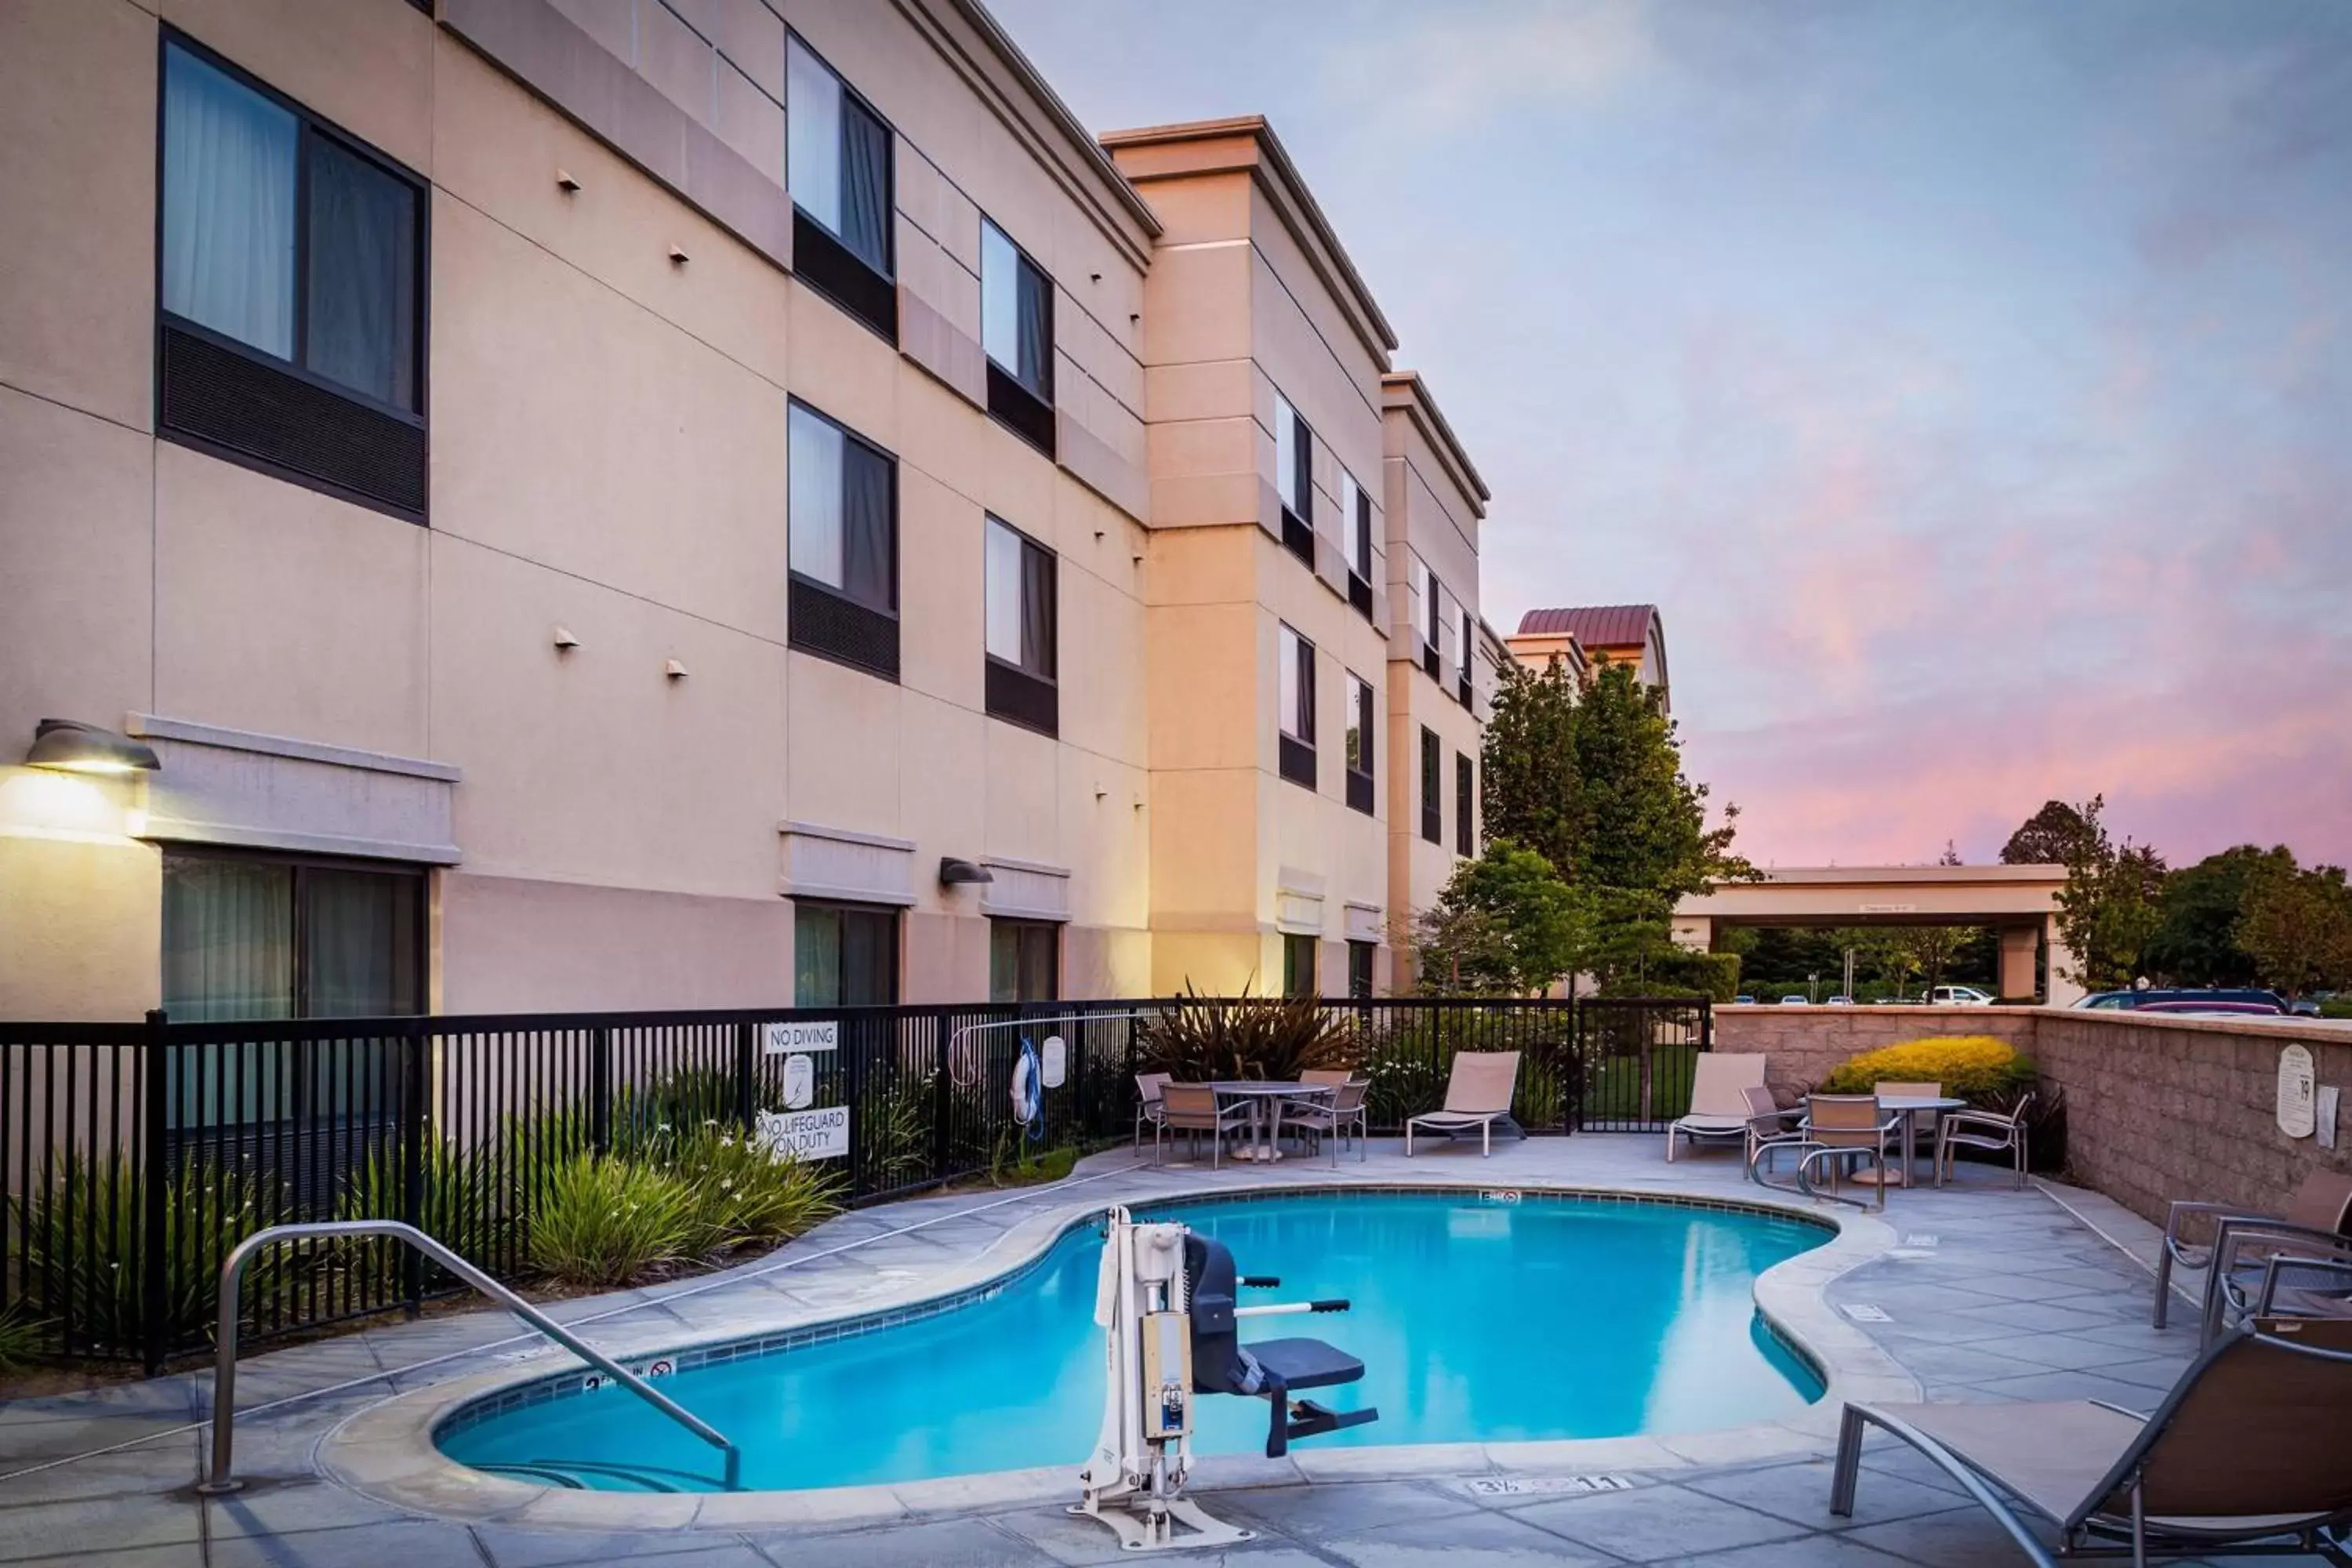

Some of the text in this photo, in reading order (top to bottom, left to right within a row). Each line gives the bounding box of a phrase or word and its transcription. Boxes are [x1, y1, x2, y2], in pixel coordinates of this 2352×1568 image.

[771, 1028, 833, 1046] NO DIVING
[761, 1112, 844, 1136] NO LIFEGUARD
[776, 1131, 831, 1153] ON DUTY
